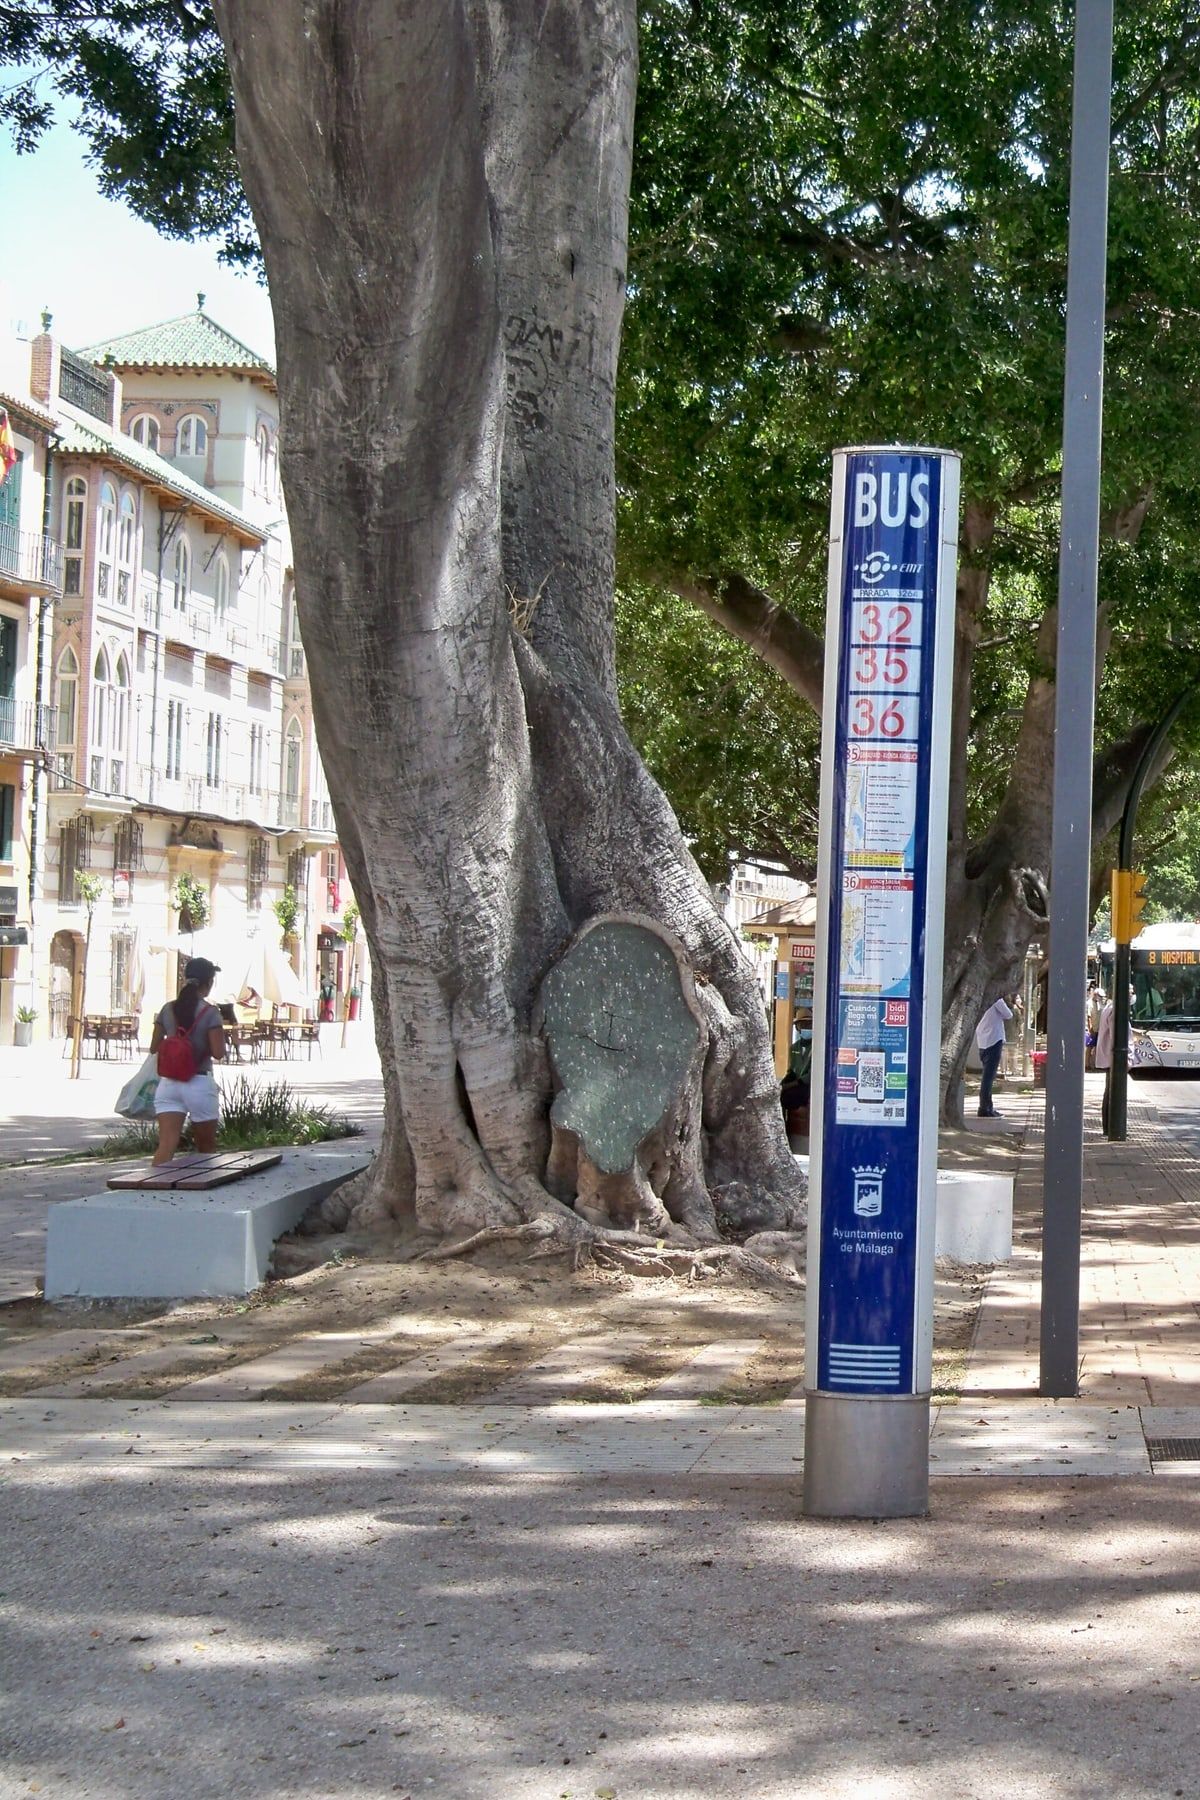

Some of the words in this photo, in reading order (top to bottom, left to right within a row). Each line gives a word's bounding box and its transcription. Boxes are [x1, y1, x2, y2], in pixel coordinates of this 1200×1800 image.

[854, 472, 929, 528] BUS
[860, 589, 889, 597] PARADA
[859, 604, 912, 643] 32
[855, 647, 908, 684] 35
[852, 698, 905, 737] 36
[843, 876, 857, 888] 36
[1149, 951, 1156, 964] 8
[1161, 951, 1197, 964] HOSPITAL
[889, 1003, 906, 1011] bidi
[848, 1012, 866, 1020] llega
[867, 1012, 877, 1020] mi
[889, 1014, 905, 1022] app
[833, 1227, 904, 1240] Ayuntamiento
[840, 1243, 853, 1252] de
[855, 1242, 894, 1256] Málaga
